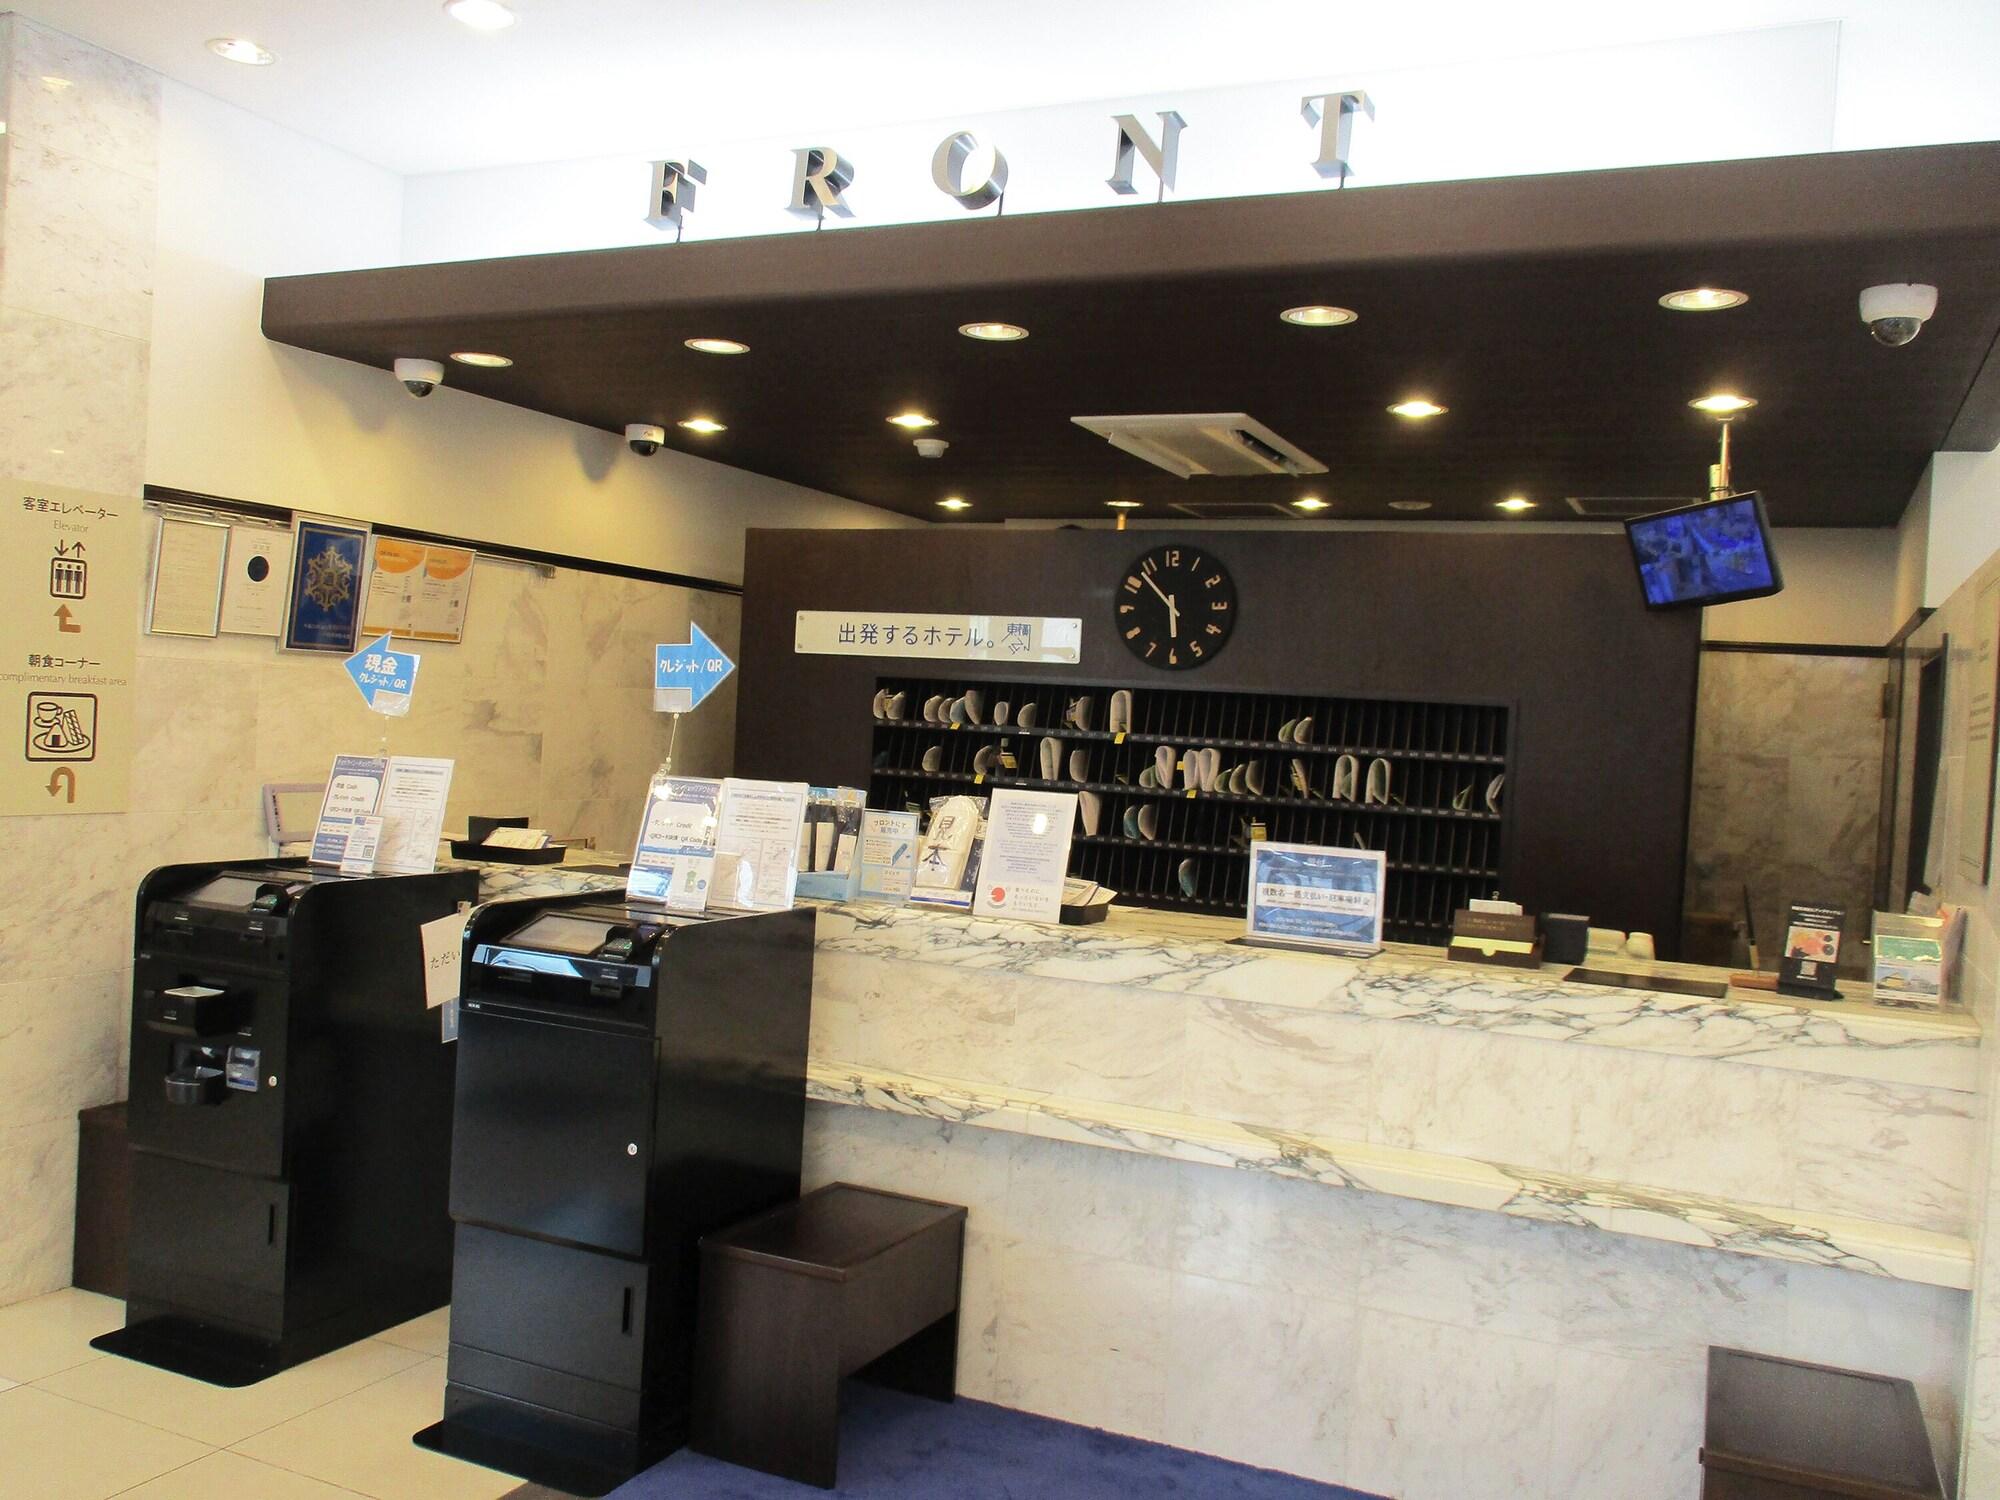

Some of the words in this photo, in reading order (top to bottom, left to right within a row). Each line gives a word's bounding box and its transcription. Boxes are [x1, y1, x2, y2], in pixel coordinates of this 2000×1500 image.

[645, 89, 1376, 231] FRONT
[23, 496, 119, 519] 客室エレベーター
[53, 519, 89, 533] Elevator
[1165, 550, 1180, 567] 12
[1124, 575, 1142, 594] 10
[1204, 574, 1221, 589] 2
[1211, 601, 1228, 611] 3
[838, 621, 994, 649] 出発するホテル。
[1205, 623, 1222, 635] 4
[1144, 641, 1157, 658] 7
[1168, 647, 1177, 665] 6
[1189, 640, 1203, 657] 5
[28, 654, 101, 669] 朝食コーナー
[364, 653, 398, 676] 現金
[68, 673, 107, 687] breakfast
[109, 678, 127, 687] area
